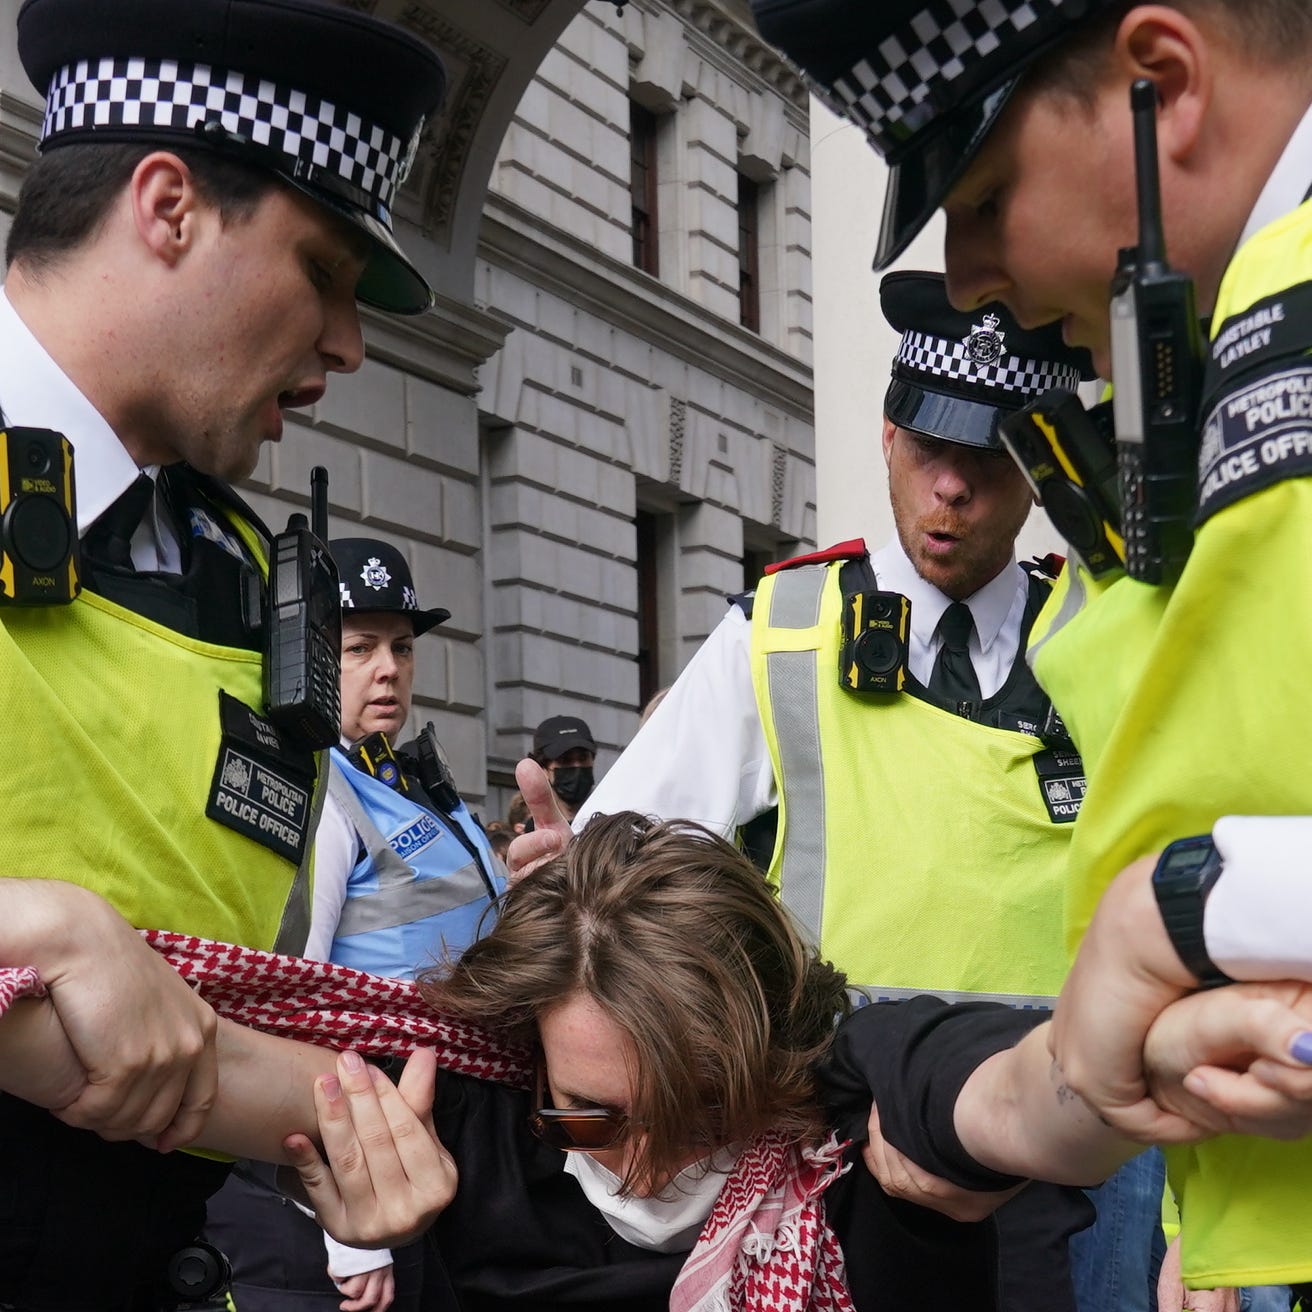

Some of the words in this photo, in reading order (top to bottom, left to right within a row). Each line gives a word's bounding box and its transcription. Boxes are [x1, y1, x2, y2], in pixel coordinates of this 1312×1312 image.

[32, 576, 56, 586] AXON
[256, 770, 304, 806] METROPOLITAN
[261, 786, 297, 817] POLICE
[215, 791, 259, 825] POLICE
[259, 814, 301, 849] OFFICER
[1052, 803, 1082, 815] POLIC
[388, 815, 436, 850] POLICE
